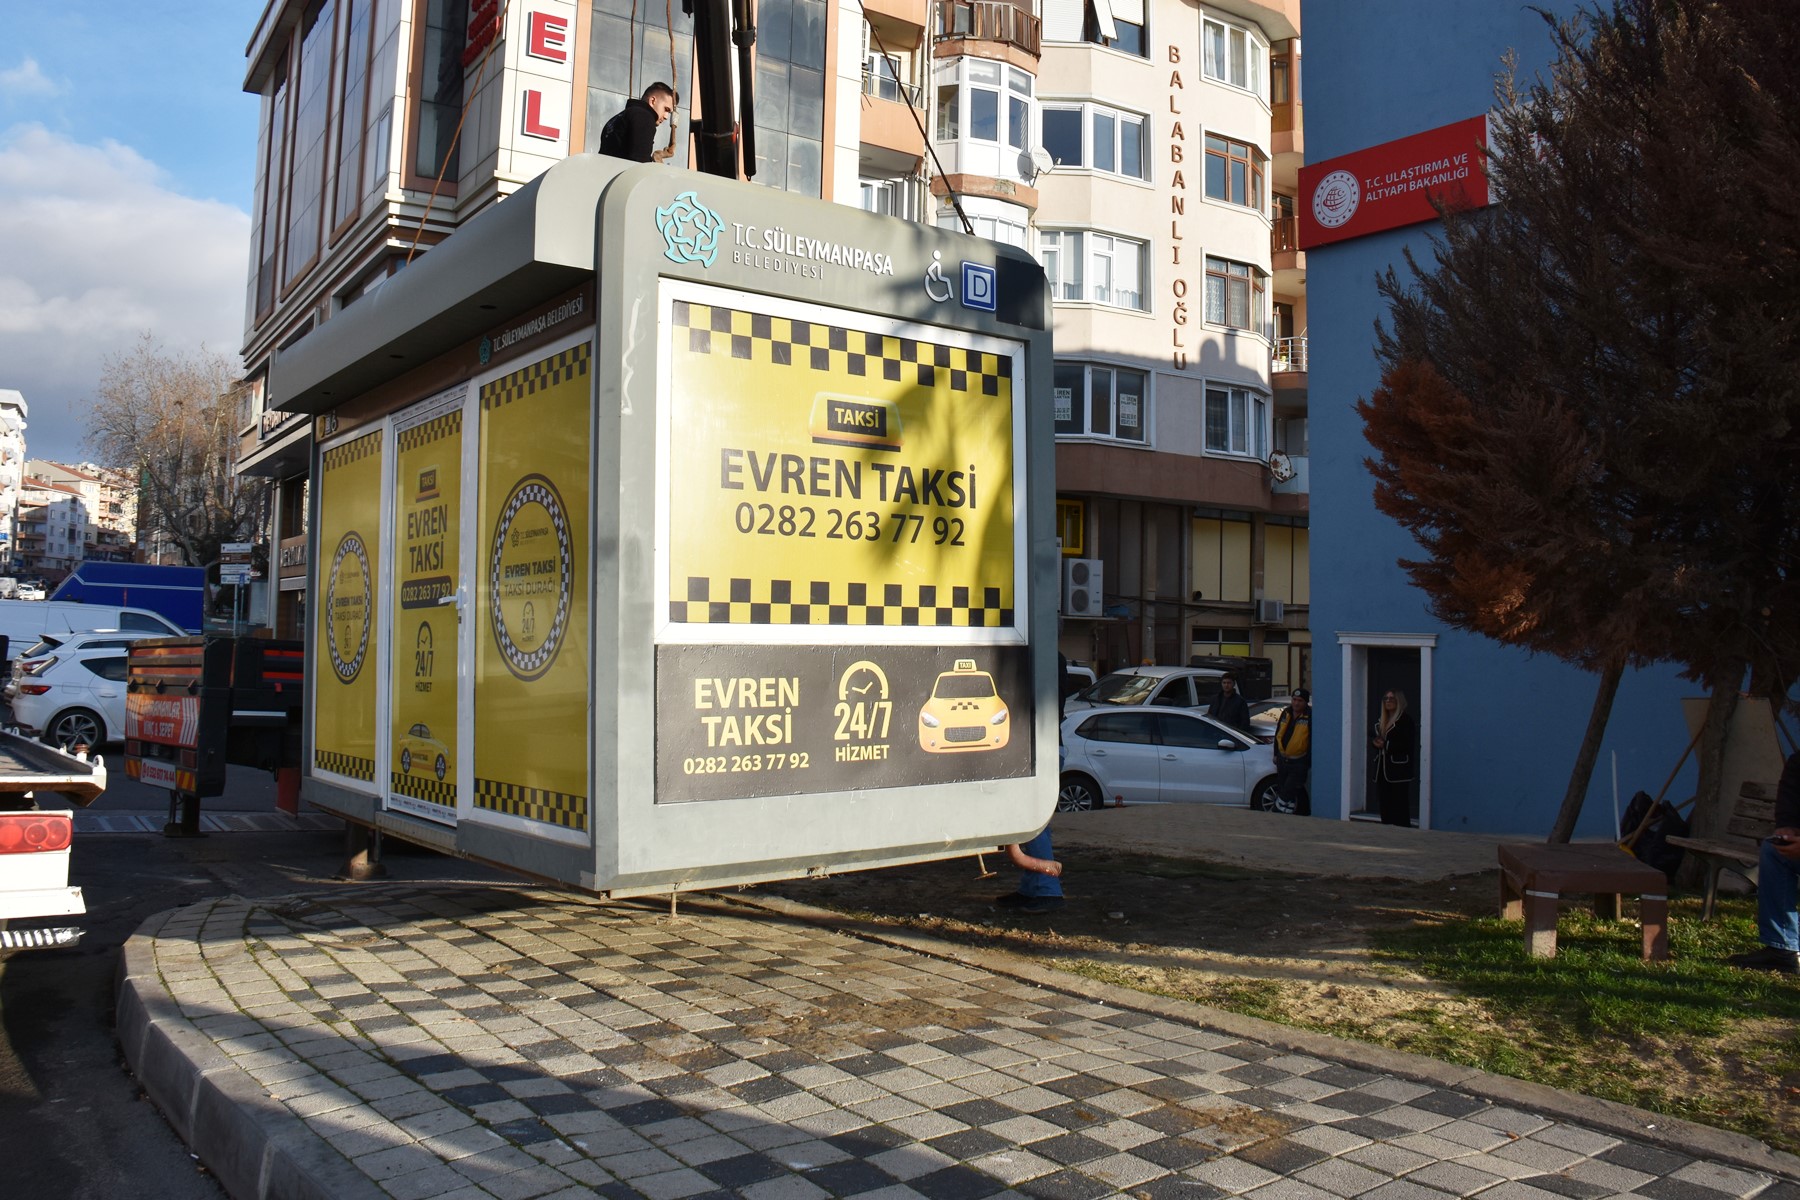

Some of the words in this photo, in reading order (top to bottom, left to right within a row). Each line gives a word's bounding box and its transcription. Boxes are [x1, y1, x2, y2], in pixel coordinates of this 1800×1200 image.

[1168, 44, 1186, 265] BALABANLI
[1365, 176, 1384, 189] T.C.
[1386, 158, 1450, 184] ULAŞTIRMA
[1453, 153, 1469, 166] VE
[1366, 184, 1407, 202] ALTYAPI
[1409, 166, 1469, 192] BAKANLIĞI
[732, 222, 761, 250] T.C.
[763, 226, 894, 276] SÜLEYMANPAŞA
[733, 250, 824, 280] BELEDİYESİ
[973, 274, 988, 298] D
[547, 293, 584, 327] BELEDİYESİ
[1172, 279, 1188, 370] OĞLU
[834, 407, 880, 429] TAKSİ
[721, 448, 862, 500] EVREN
[871, 464, 977, 510] TAKSİ
[407, 504, 448, 540] EVREN
[735, 501, 817, 538] 0282
[826, 508, 881, 542] 263
[890, 513, 924, 544] 77
[933, 517, 966, 547] 92
[409, 534, 444, 574] TAKSİ
[504, 562, 531, 578] EVREN
[532, 556, 556, 575] TAKSİ
[402, 585, 417, 602] 0282
[418, 585, 431, 600] 263
[432, 583, 440, 598] 77
[504, 580, 524, 597] TAKSİ
[525, 577, 556, 596] DURAĞI
[522, 617, 535, 634] 24/7
[415, 650, 434, 678] 24/7
[415, 680, 433, 692] HİZMET
[694, 677, 799, 709] EVREN
[701, 706, 792, 748] TAKSİ
[834, 701, 893, 741] 24/7
[683, 756, 727, 775] 0282
[731, 754, 762, 772] 263
[766, 753, 786, 770] 77
[789, 752, 810, 769] 92
[835, 744, 890, 762] HİZMET
